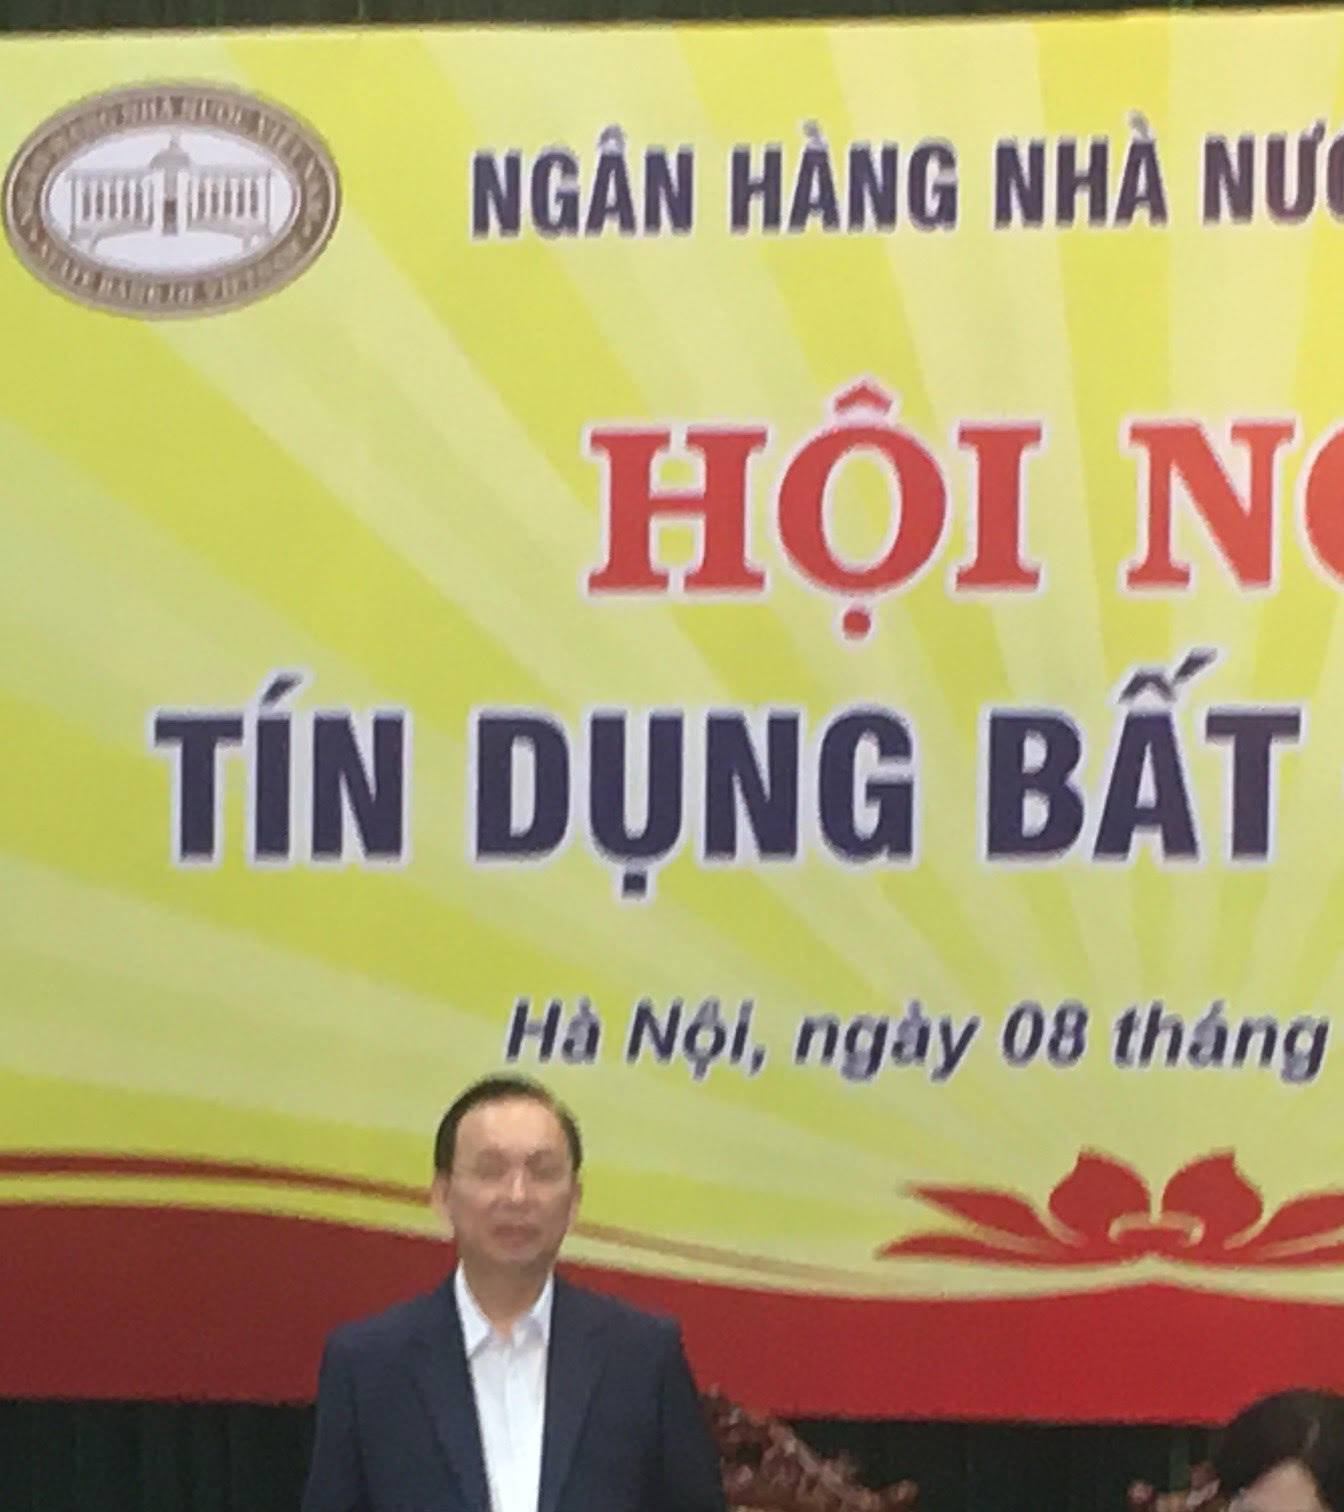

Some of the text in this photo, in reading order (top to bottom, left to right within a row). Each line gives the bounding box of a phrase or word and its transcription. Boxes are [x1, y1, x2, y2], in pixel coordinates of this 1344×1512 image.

[471, 122, 694, 239] NGÂN
[730, 117, 958, 235] HÀNG
[994, 109, 1168, 230] NHÀ
[587, 380, 1043, 638] HỘI
[153, 673, 406, 863] TÍN
[474, 709, 915, 899] DỤNG
[986, 649, 1303, 863] BẤT
[504, 998, 601, 1064] Hà
[626, 997, 766, 1081] Nội,
[794, 998, 981, 1083] ngày
[1002, 1001, 1089, 1067] 08
[1114, 1000, 1330, 1085] tháng
